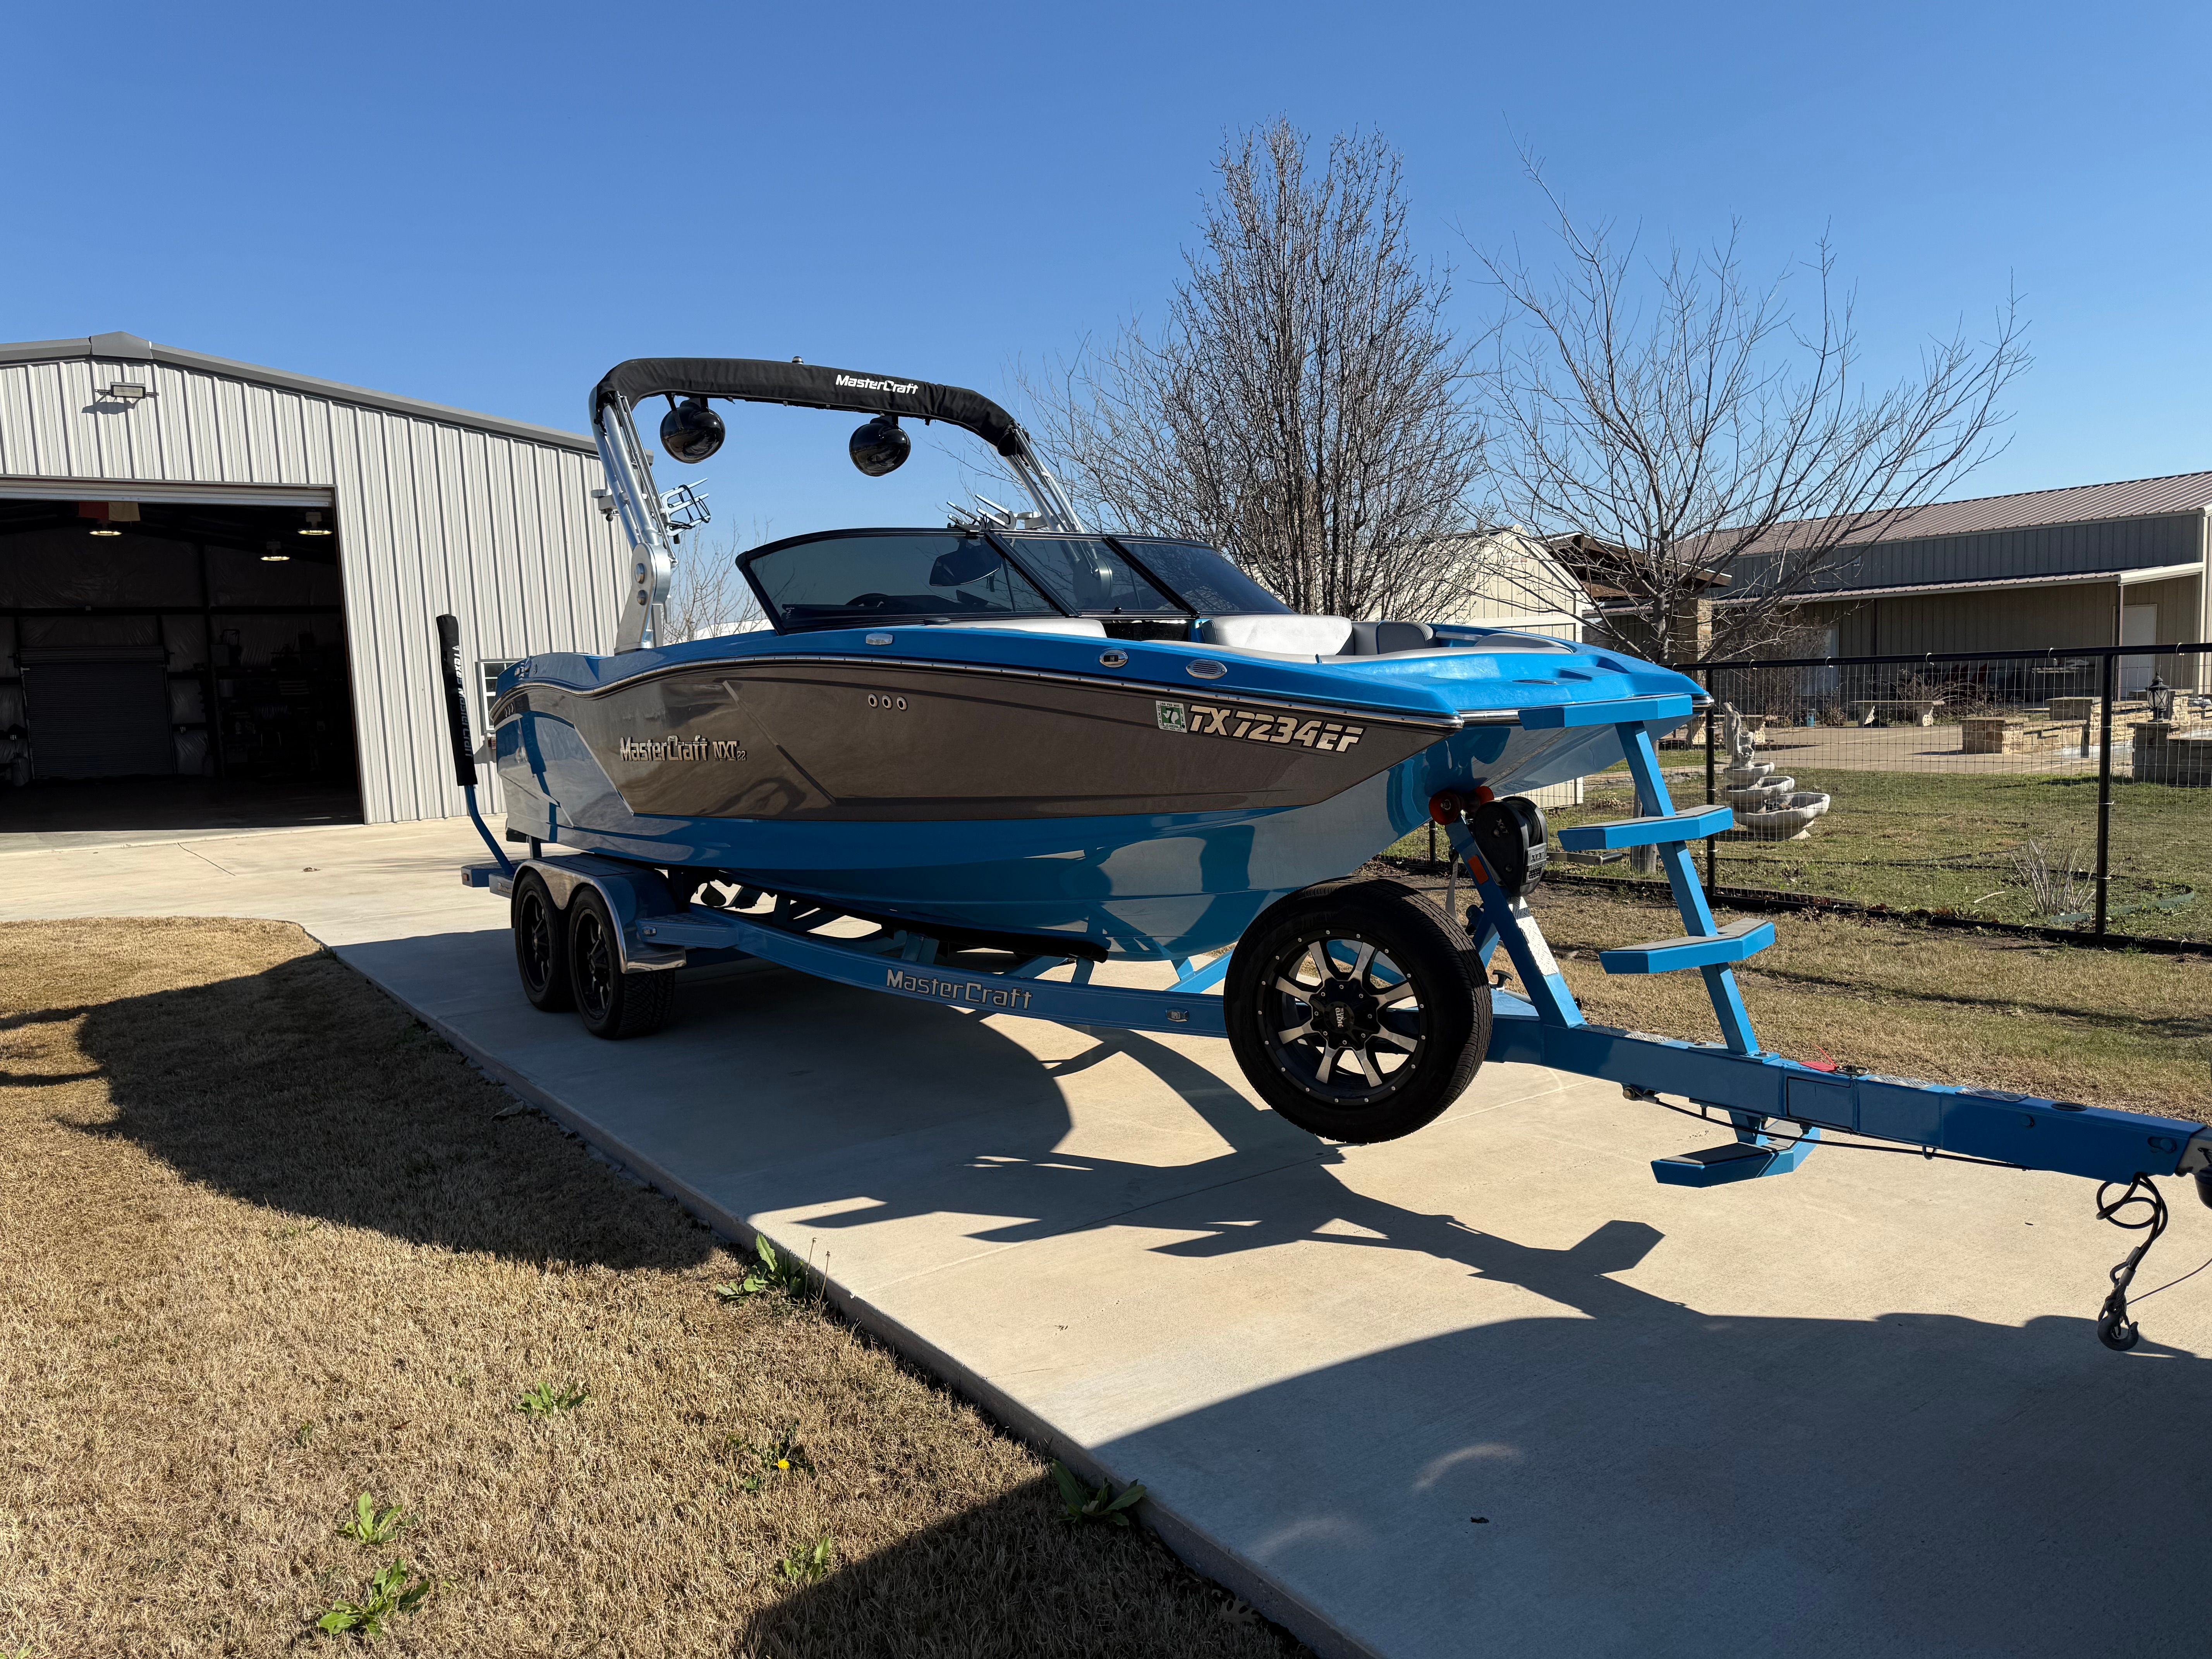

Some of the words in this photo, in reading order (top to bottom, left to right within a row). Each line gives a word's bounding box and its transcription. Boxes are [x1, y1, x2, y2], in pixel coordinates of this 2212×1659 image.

[835, 374, 919, 395] MasterCraft
[620, 735, 708, 761] MasterCraft
[886, 968, 1033, 1010] MasterCraft
[1335, 1007, 1343, 1028] MOTO
